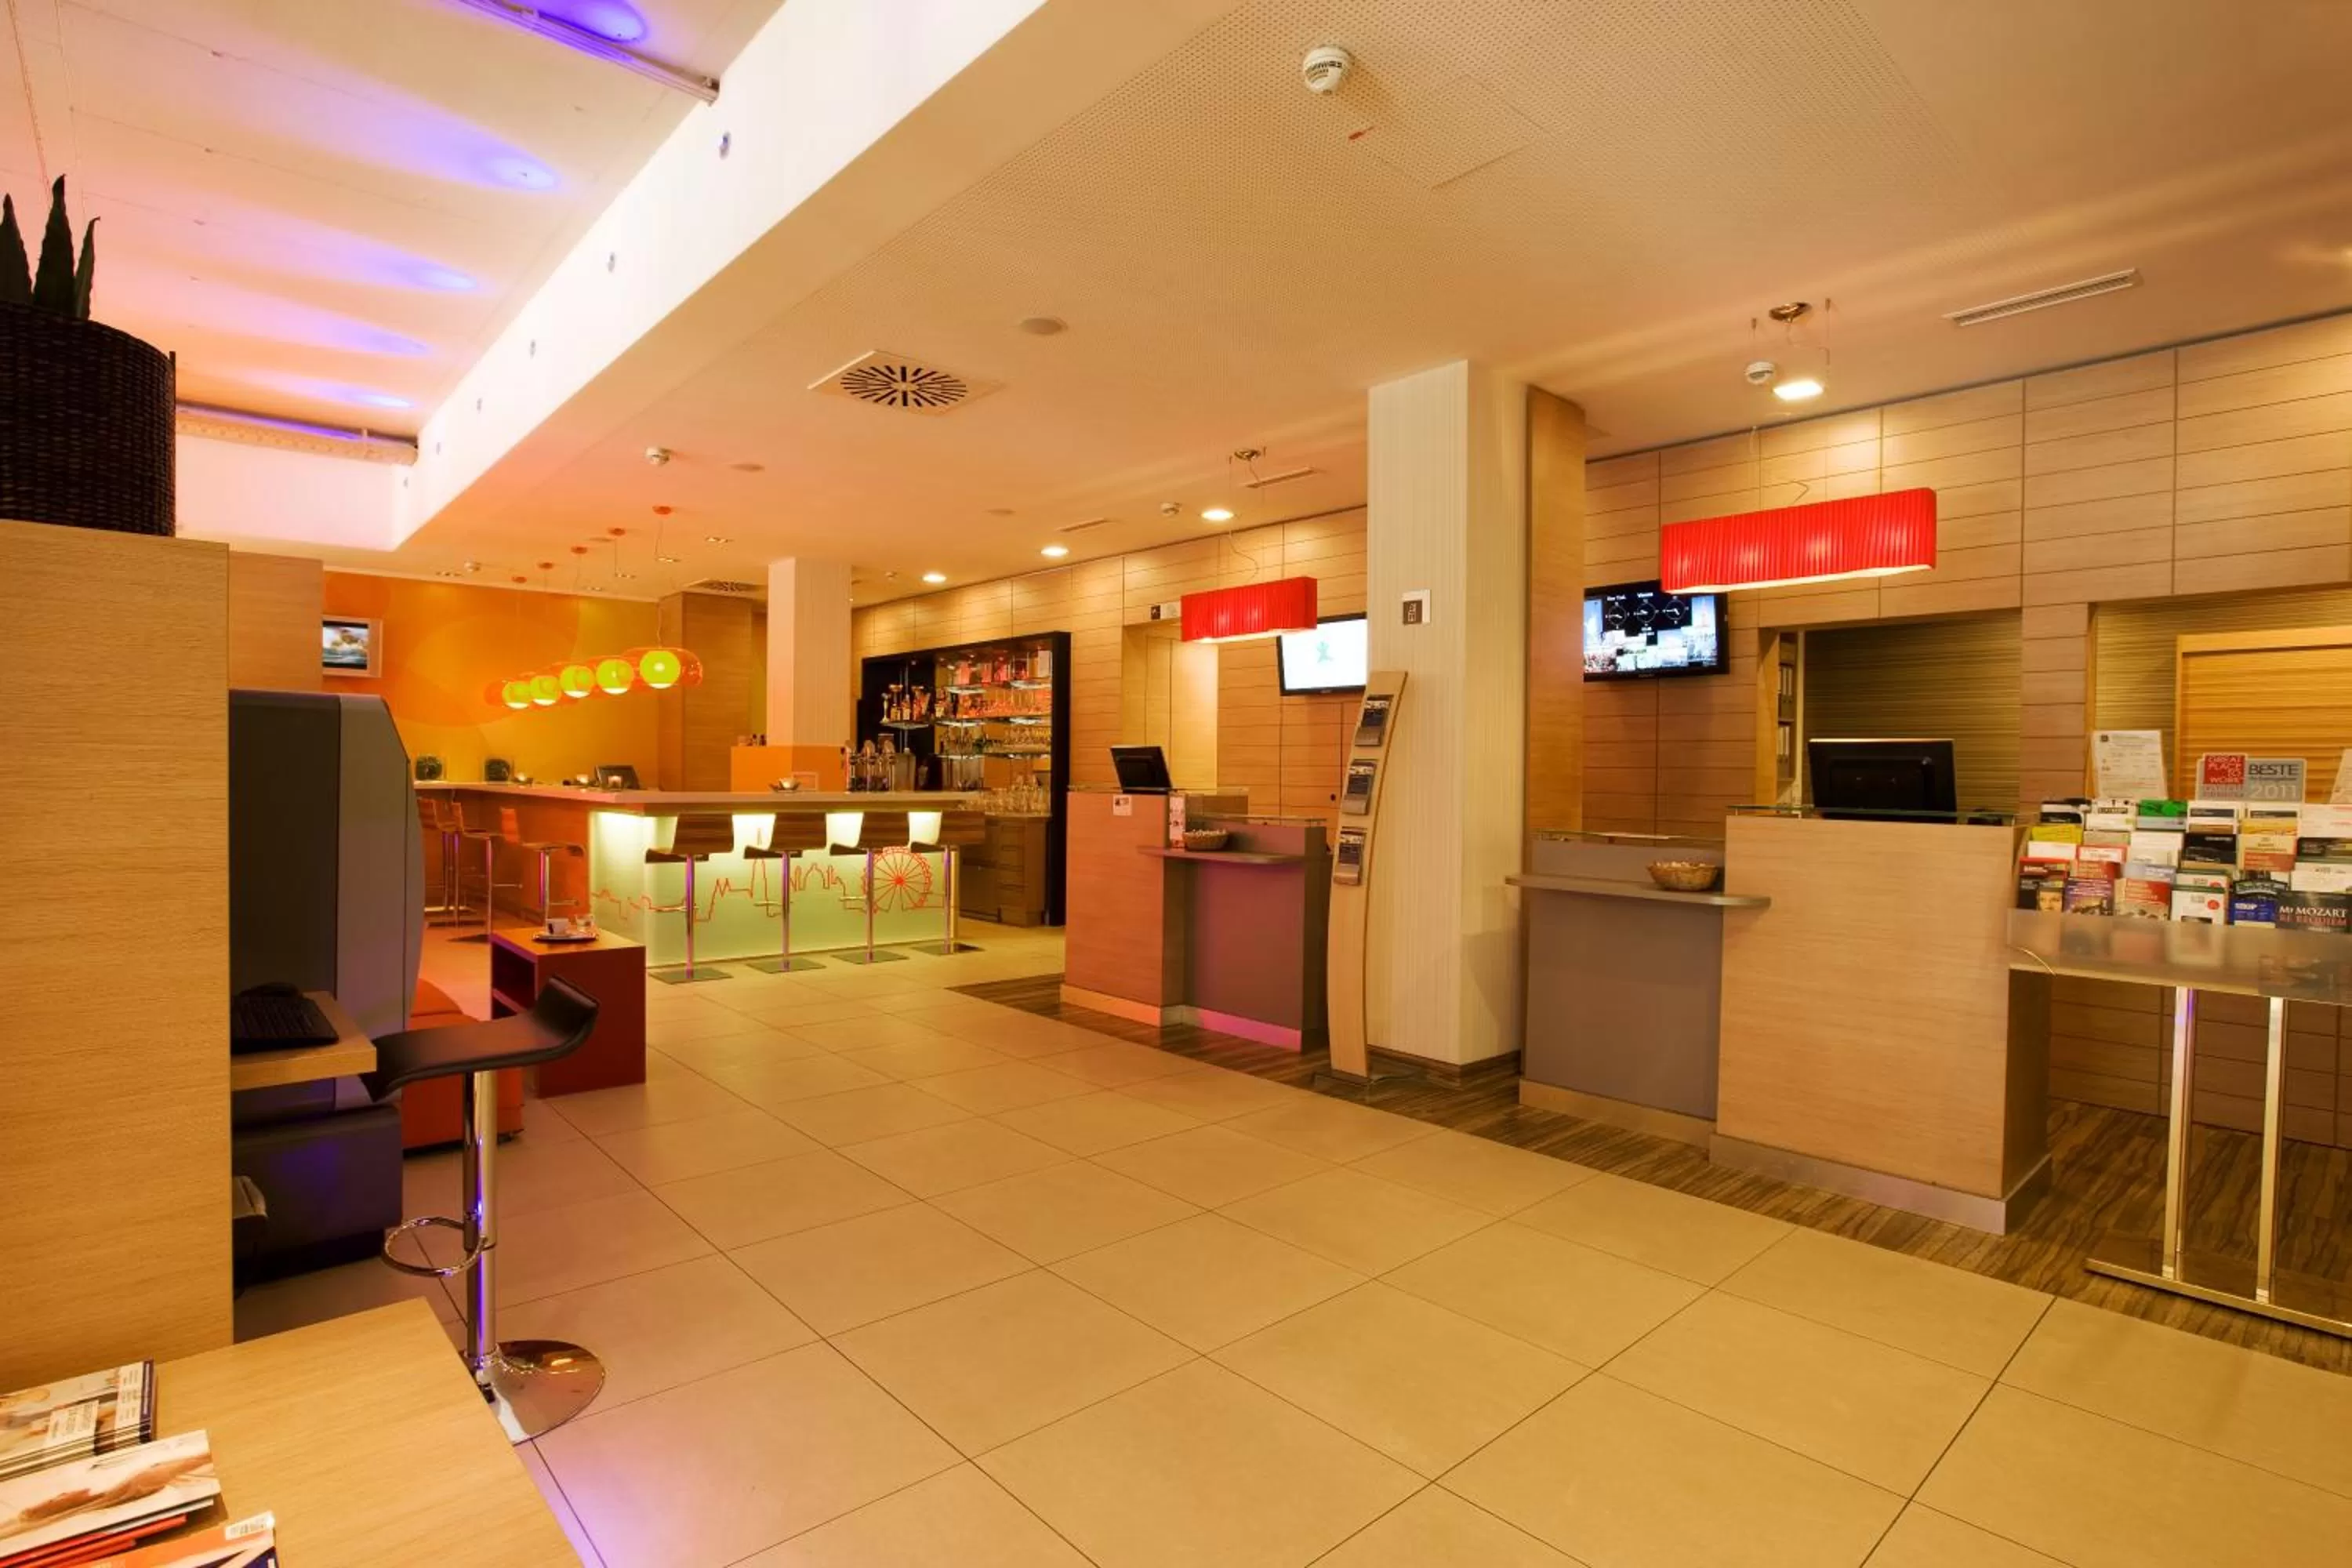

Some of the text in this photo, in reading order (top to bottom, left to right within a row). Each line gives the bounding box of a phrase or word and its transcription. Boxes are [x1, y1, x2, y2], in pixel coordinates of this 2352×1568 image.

[2249, 764, 2299, 776] BESTE
[2249, 784, 2297, 800] 2011
[2296, 906, 2348, 918] MOZART
